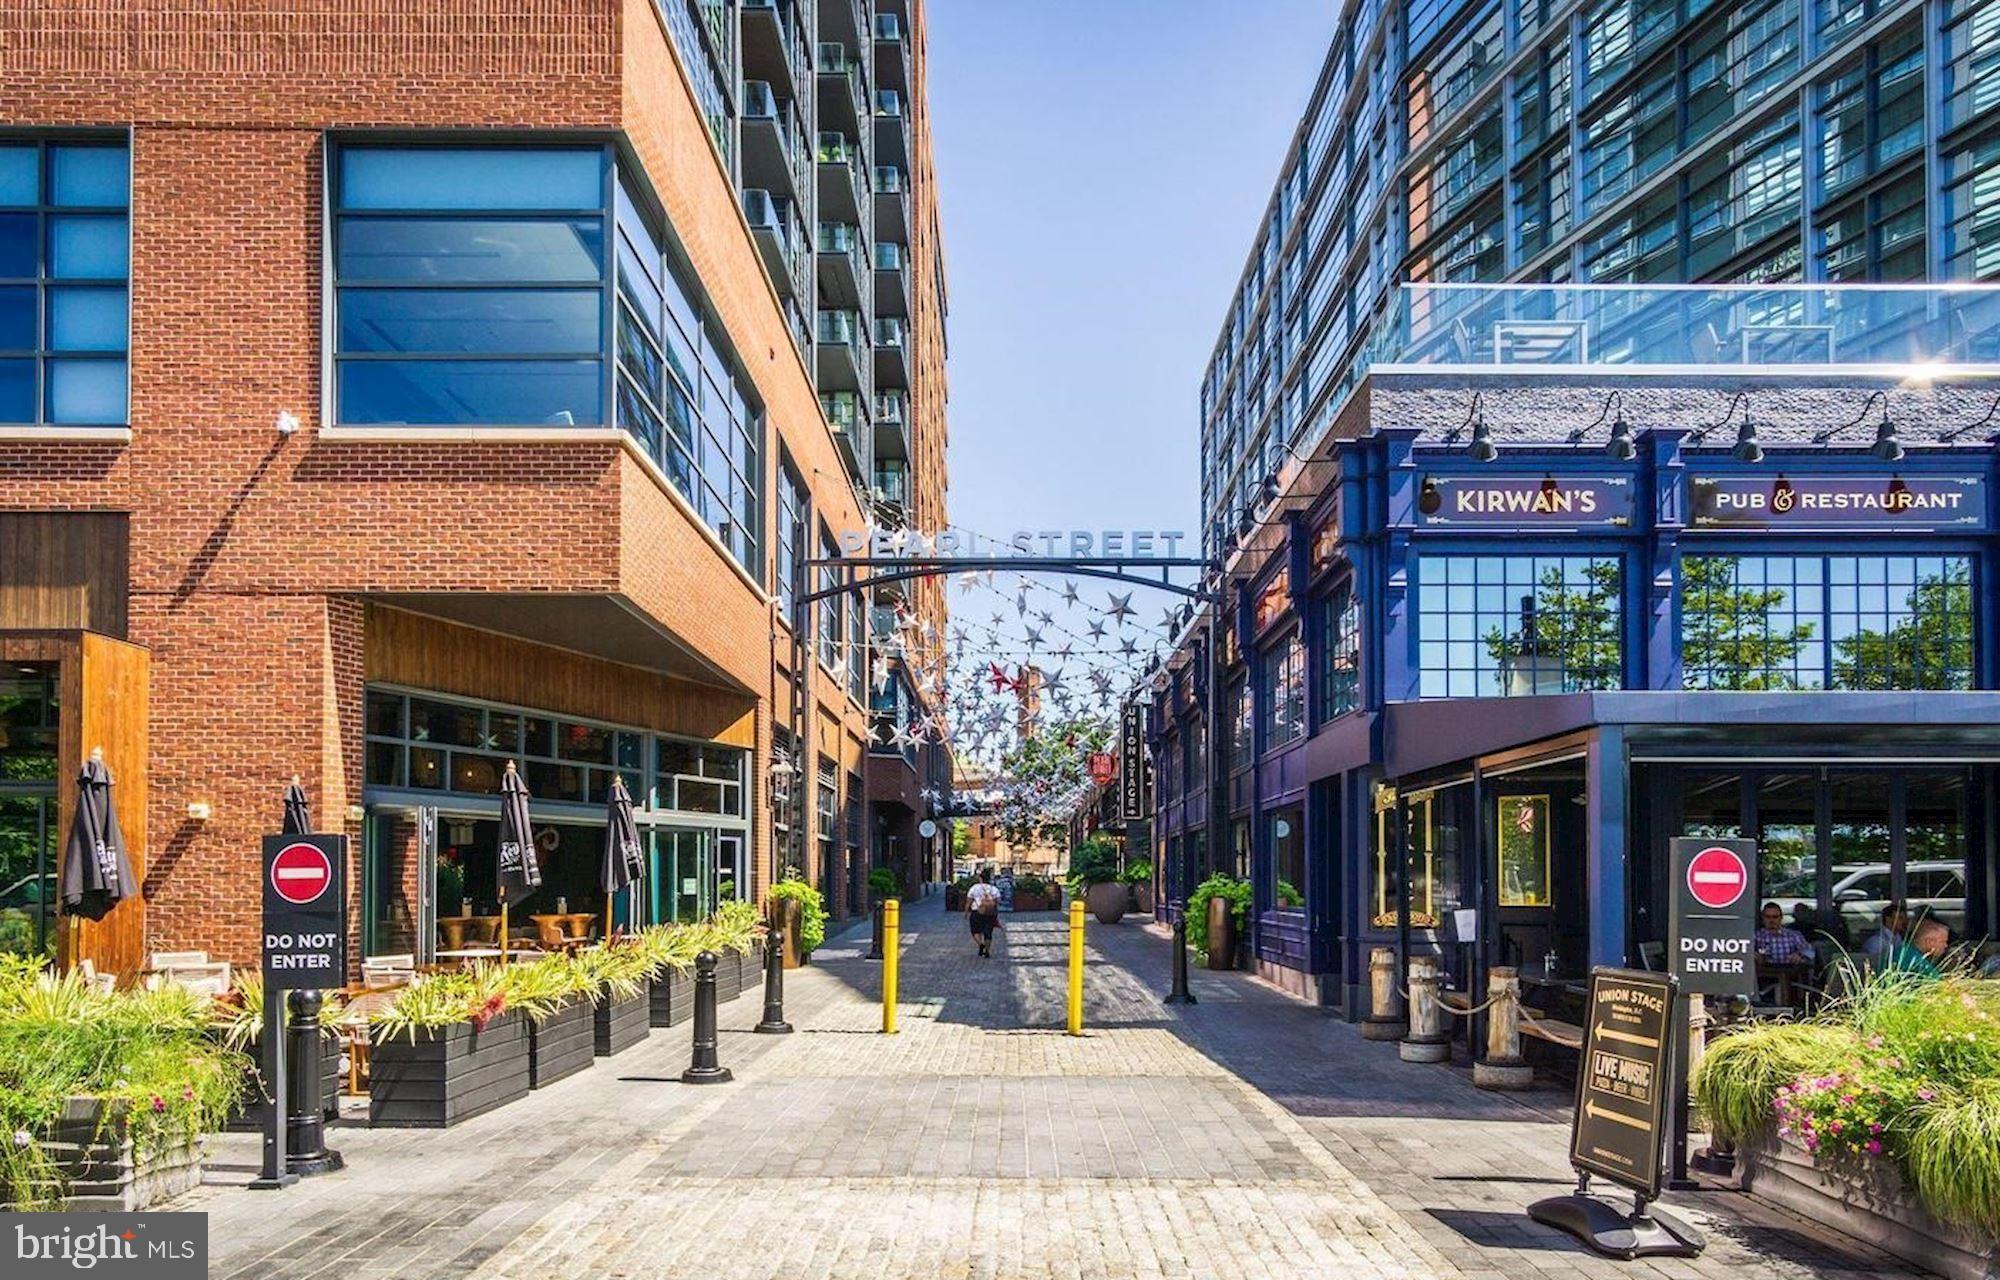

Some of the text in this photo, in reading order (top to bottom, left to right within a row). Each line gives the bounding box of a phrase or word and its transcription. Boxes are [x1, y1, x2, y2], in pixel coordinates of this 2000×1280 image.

[1457, 490, 1597, 512] KIRWAN'S
[1716, 489, 1963, 511] PUB & RESTAURANT
[841, 530, 1184, 559] PEARL STREET
[1127, 707, 1137, 807] UNION STAGE
[266, 933, 337, 948] DO NOT
[1680, 937, 1750, 953] DO NOT
[271, 954, 331, 969] ENTER
[1685, 957, 1744, 974] ENTER
[1598, 989, 1630, 1003] UNION
[1630, 990, 1664, 1014] STAGE
[1595, 1054, 1618, 1080] LIVE
[1618, 1060, 1650, 1088] MUSIC
